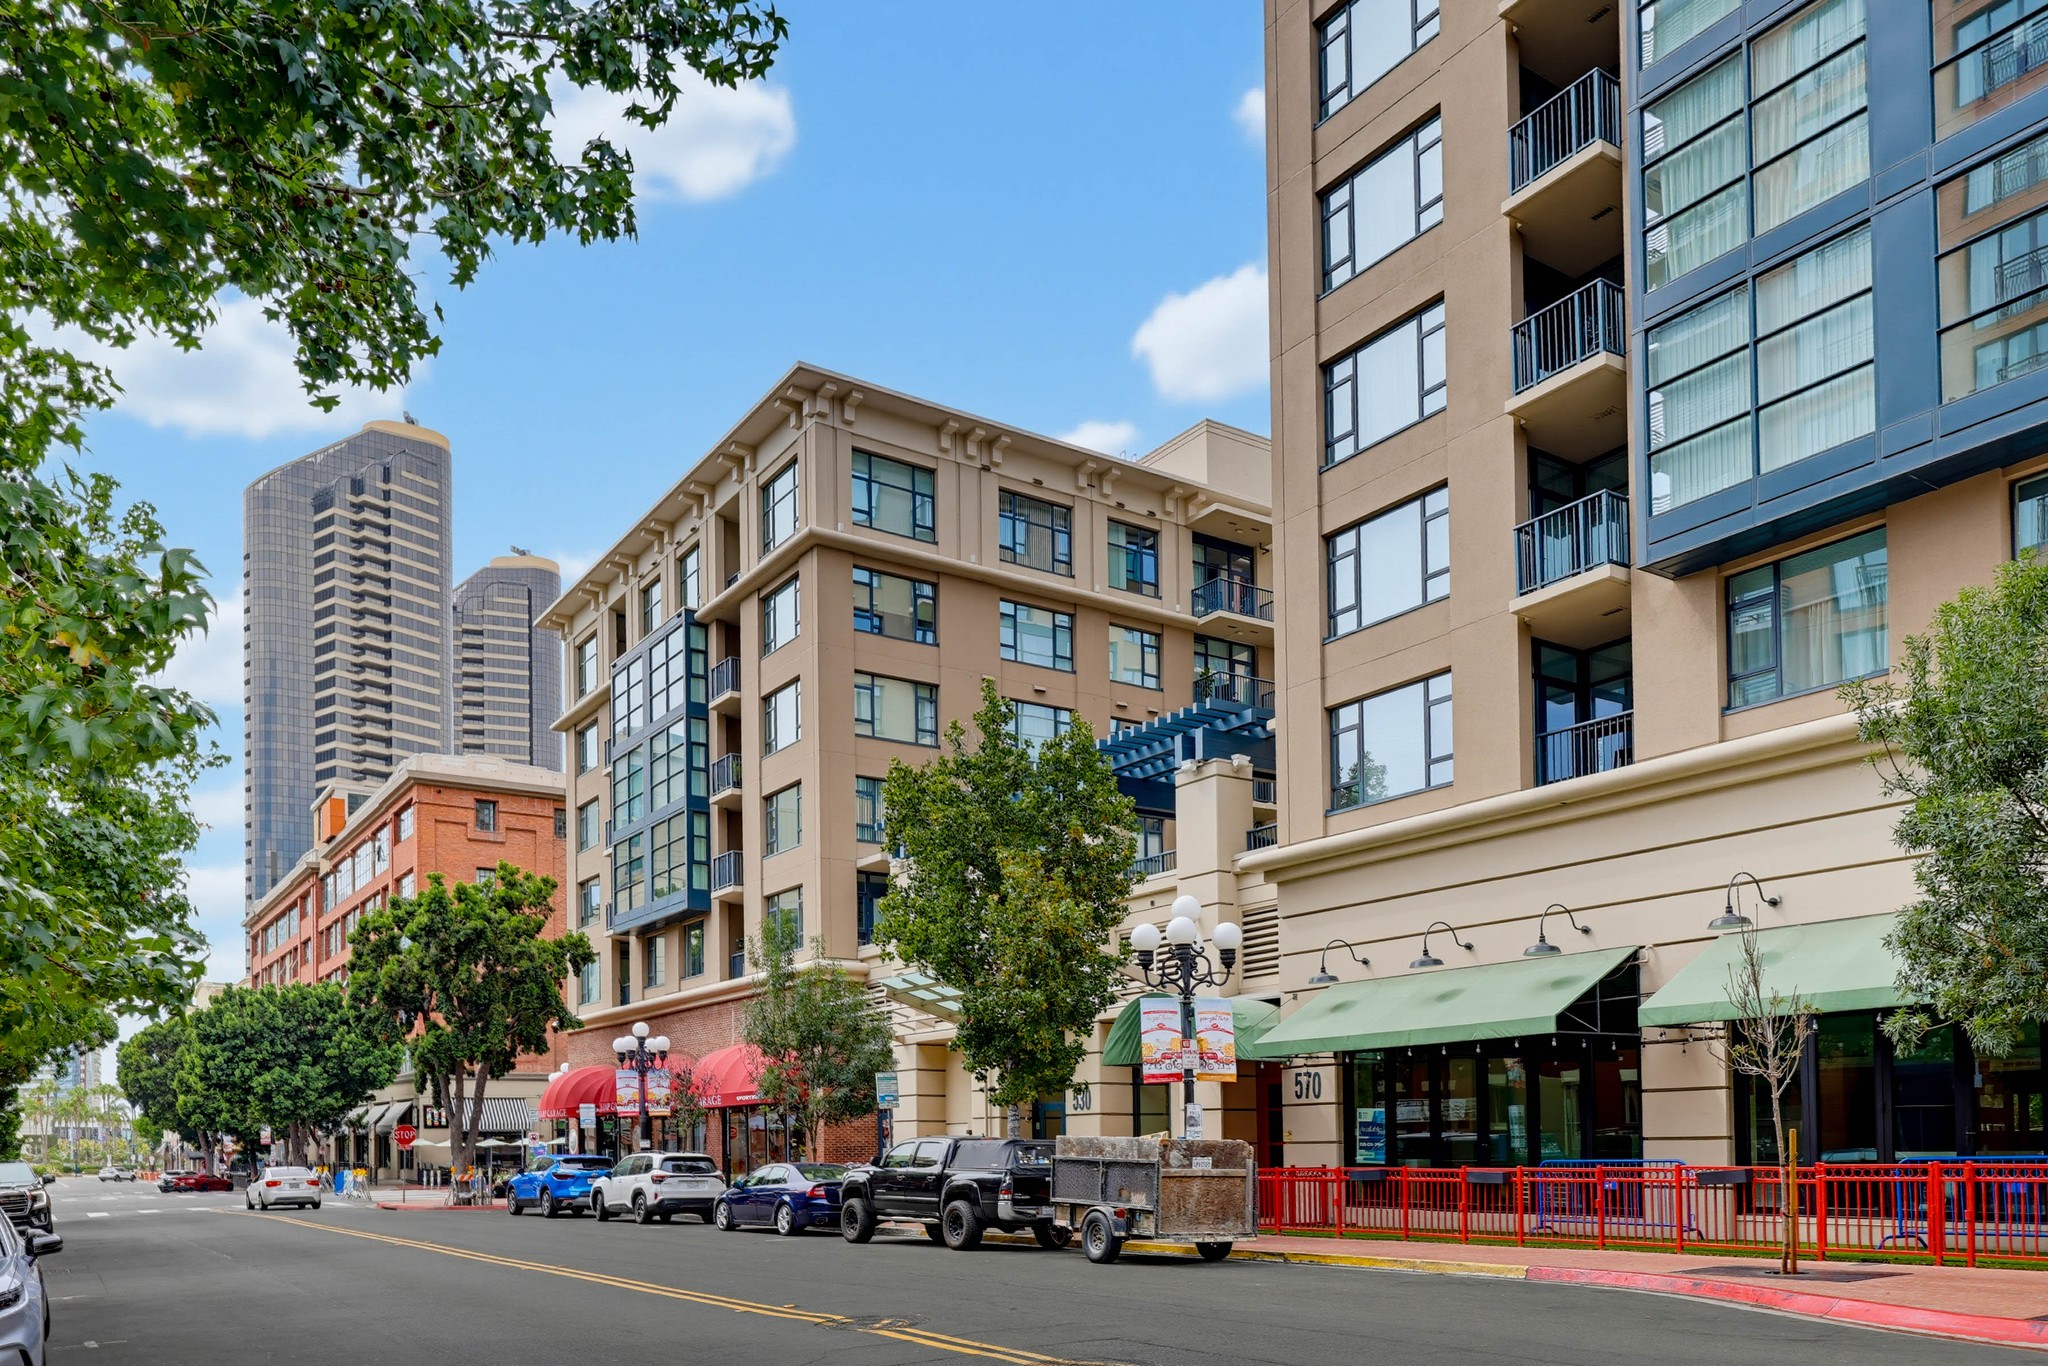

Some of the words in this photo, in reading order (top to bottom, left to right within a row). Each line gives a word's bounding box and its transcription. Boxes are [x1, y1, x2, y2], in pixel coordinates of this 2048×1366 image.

[1295, 1072, 1321, 1099] 570
[1073, 1087, 1091, 1111] 530
[395, 1131, 416, 1139] STOP
